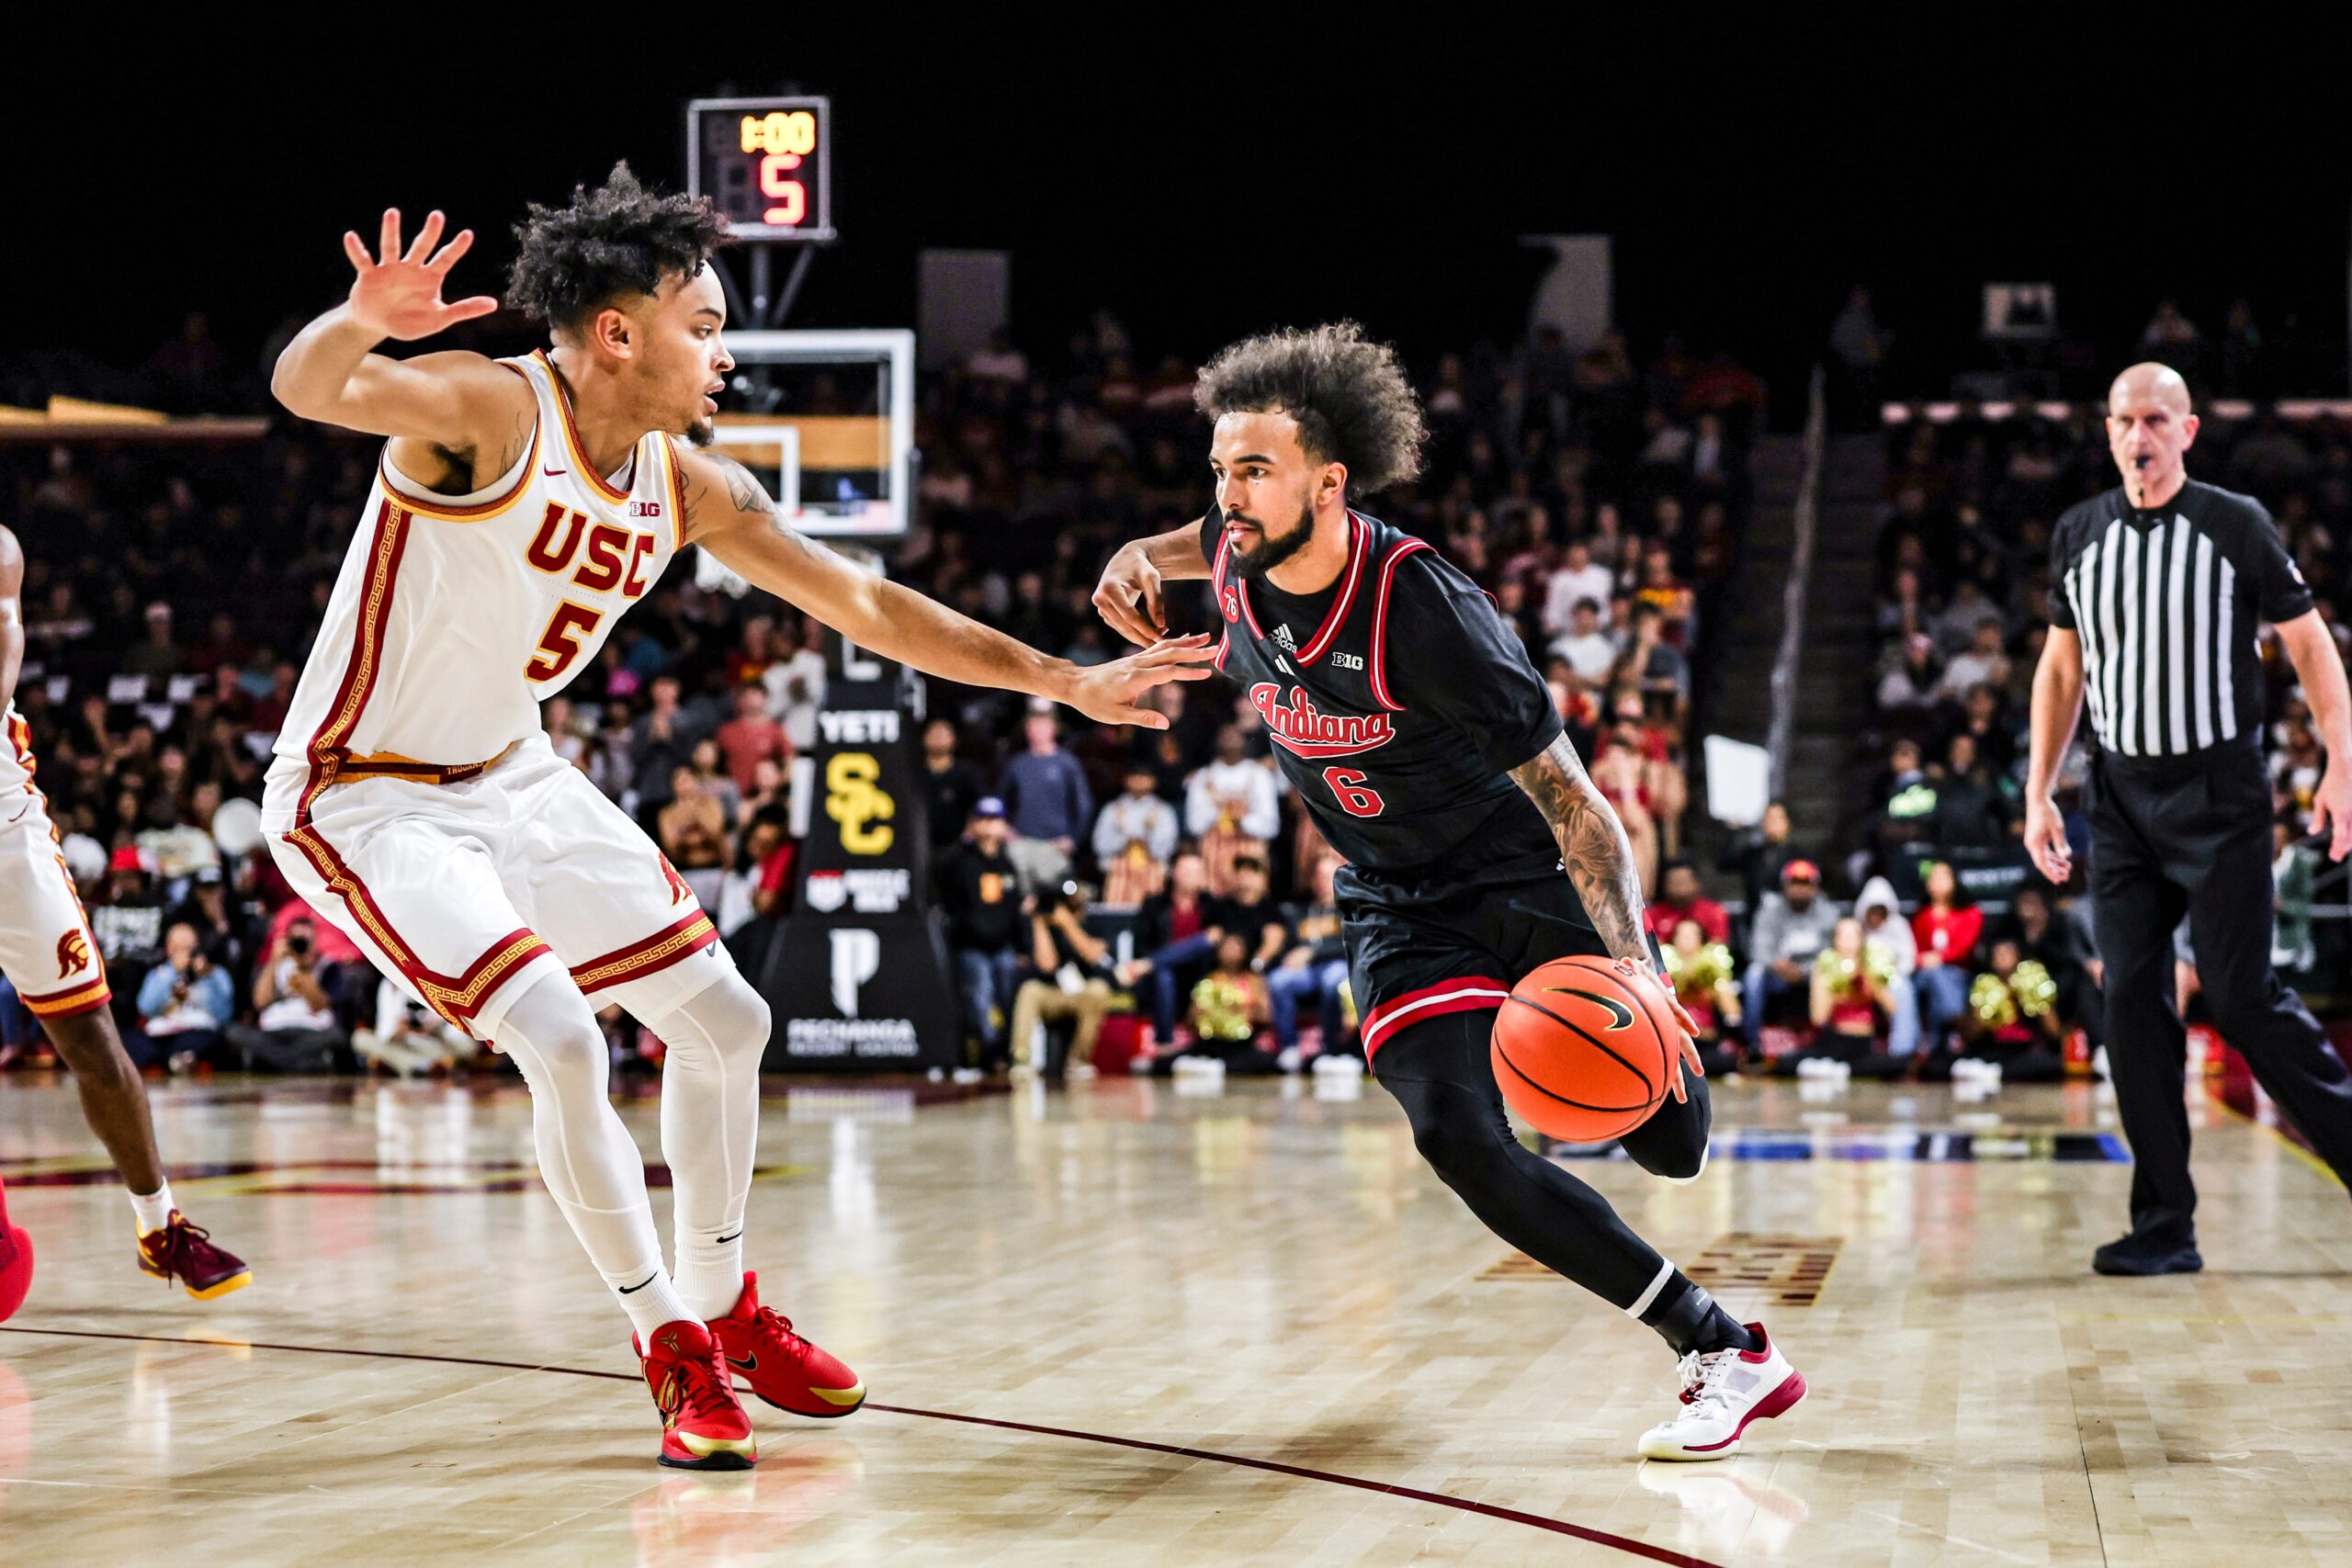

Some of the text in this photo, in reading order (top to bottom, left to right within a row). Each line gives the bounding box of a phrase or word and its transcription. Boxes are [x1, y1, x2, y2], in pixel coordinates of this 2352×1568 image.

[761, 153, 805, 225] 5
[525, 500, 657, 600] USC
[1224, 592, 1237, 616] 76
[524, 598, 605, 683] 5
[820, 710, 900, 743] YETI
[1250, 682, 1396, 748] Indiana
[1322, 766, 1385, 818] 6
